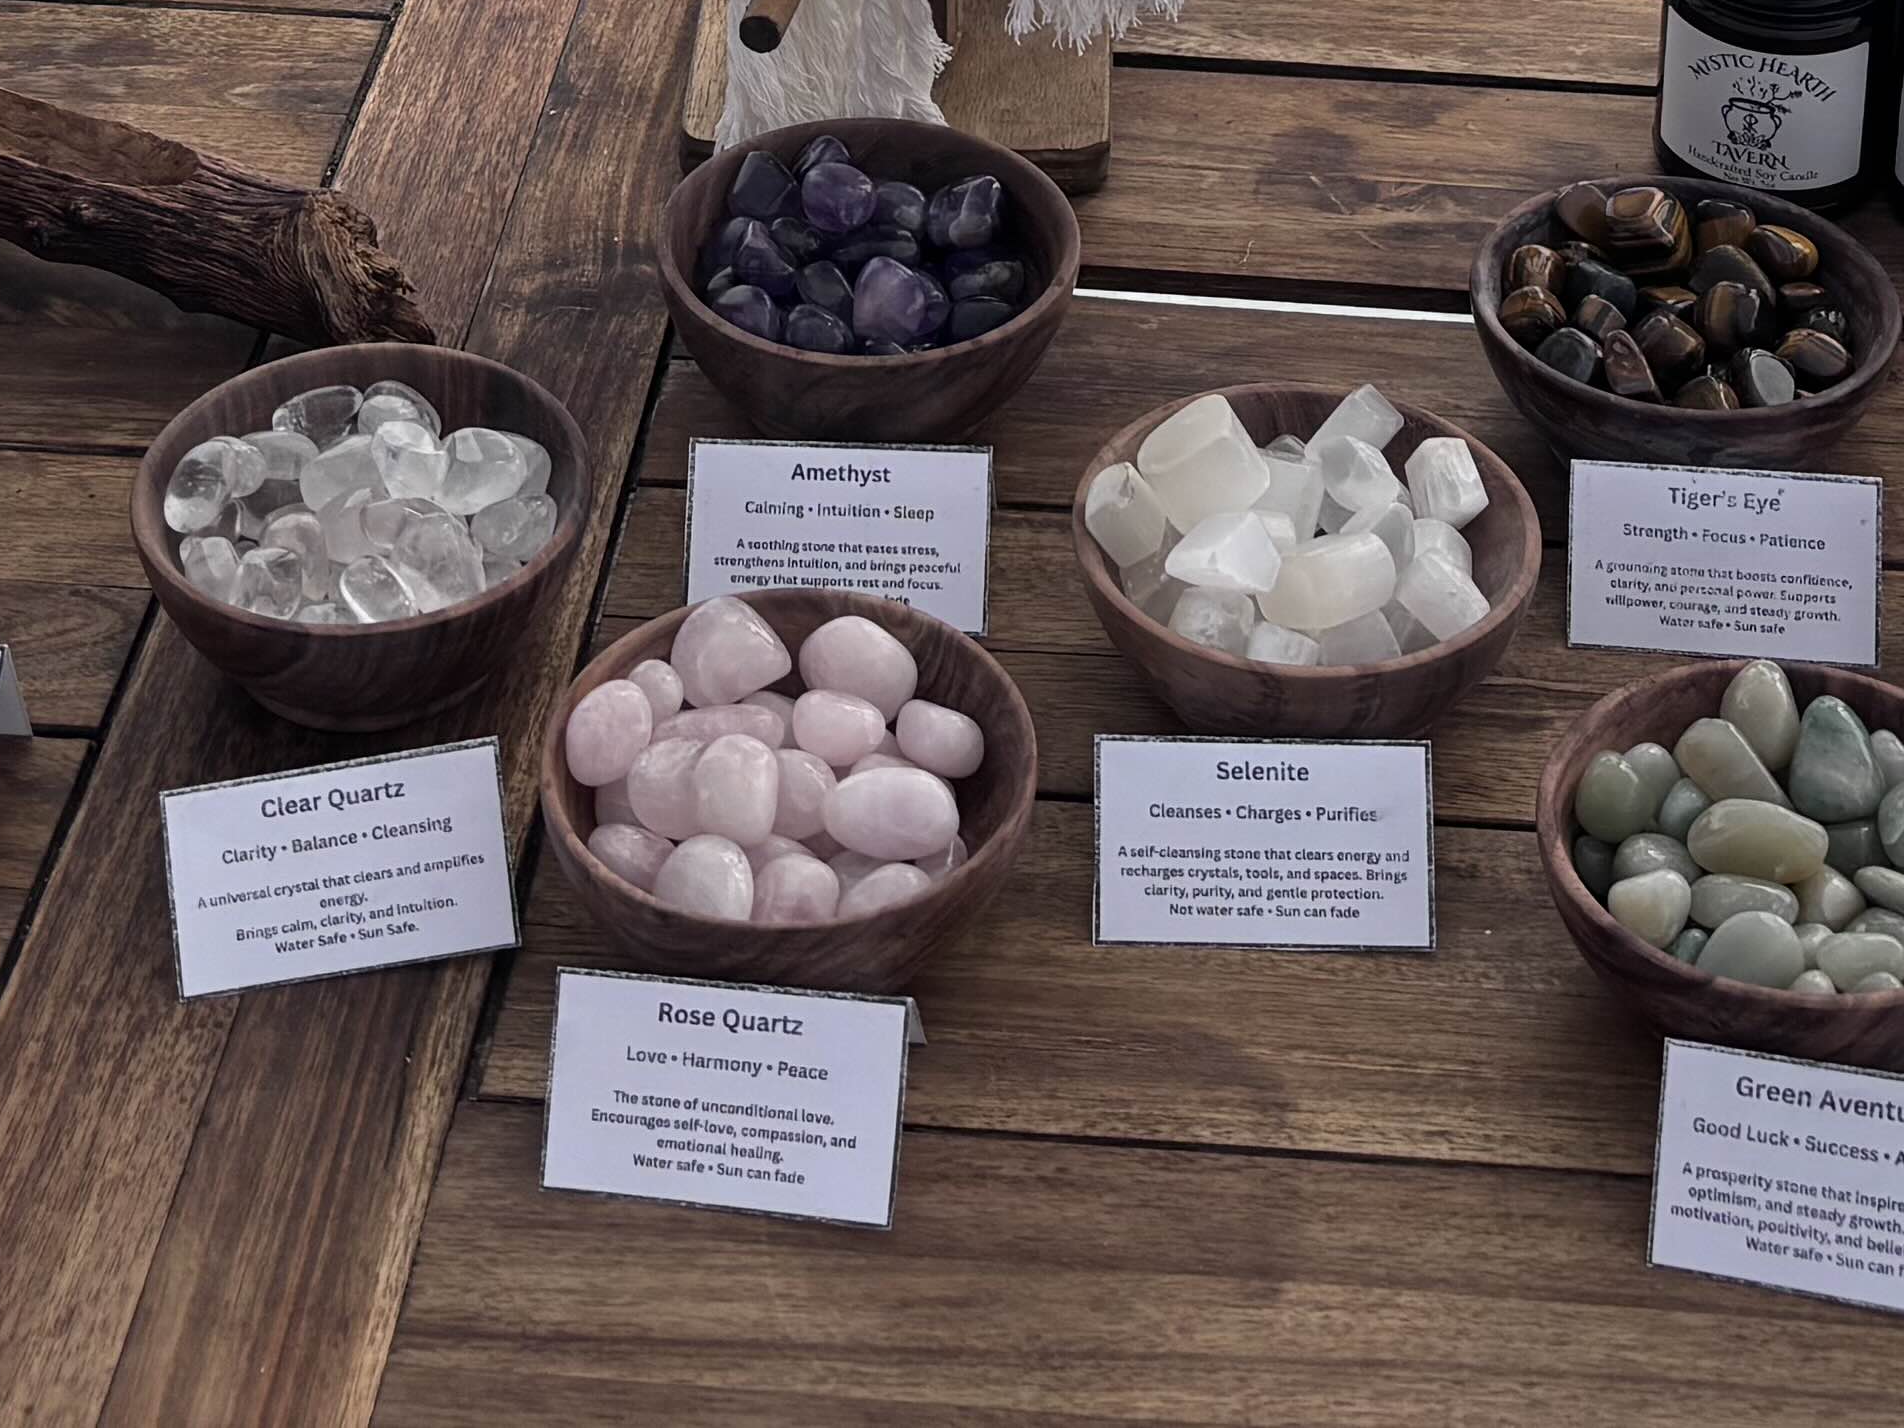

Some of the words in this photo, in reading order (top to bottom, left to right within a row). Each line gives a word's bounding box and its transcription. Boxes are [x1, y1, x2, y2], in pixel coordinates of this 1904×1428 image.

[1688, 54, 1754, 80] MYSTIC
[1758, 57, 1837, 102] HEARTH
[1712, 140, 1791, 170] TAVERN
[791, 464, 891, 487] Amethyst
[745, 501, 804, 519] Calming
[818, 504, 880, 518] Intuition
[894, 506, 934, 522] Sleep
[1668, 487, 1736, 510] Tiger's
[1744, 493, 1780, 515] Eye
[1624, 523, 1688, 542] Strength
[1702, 529, 1746, 544] Focus
[1760, 533, 1825, 550] Patience
[1217, 761, 1309, 781] Selenite
[261, 796, 322, 818] Clear
[328, 782, 405, 811] Quartz
[1149, 803, 1222, 819] Cleanses
[1236, 804, 1301, 824] Charges
[1316, 807, 1377, 822] Purifies
[222, 845, 277, 864] Clarity
[292, 833, 357, 853] Balance
[372, 817, 452, 840] Cleansing
[1170, 904, 1194, 915] Not
[1196, 906, 1234, 916] water
[1237, 905, 1264, 916] safe
[1276, 905, 1300, 917] Sun
[1304, 908, 1327, 918] can
[1330, 906, 1360, 918] fade
[275, 939, 315, 953] Water
[318, 932, 347, 946] Safe
[358, 928, 383, 940] Sun
[658, 1002, 715, 1027] Rose
[722, 1009, 803, 1036] Quartz
[627, 1046, 667, 1064] Love
[683, 1052, 762, 1077] Harmony
[778, 1061, 828, 1080] Peace
[1736, 1076, 1812, 1108] Green
[1693, 1117, 1741, 1139] Good
[1747, 1125, 1789, 1147] Luck
[1805, 1135, 1879, 1162] Success
[633, 1154, 673, 1169] Water
[677, 1159, 705, 1173] safe
[717, 1163, 743, 1178] Sun
[747, 1169, 771, 1181] can
[775, 1169, 805, 1184] fade
